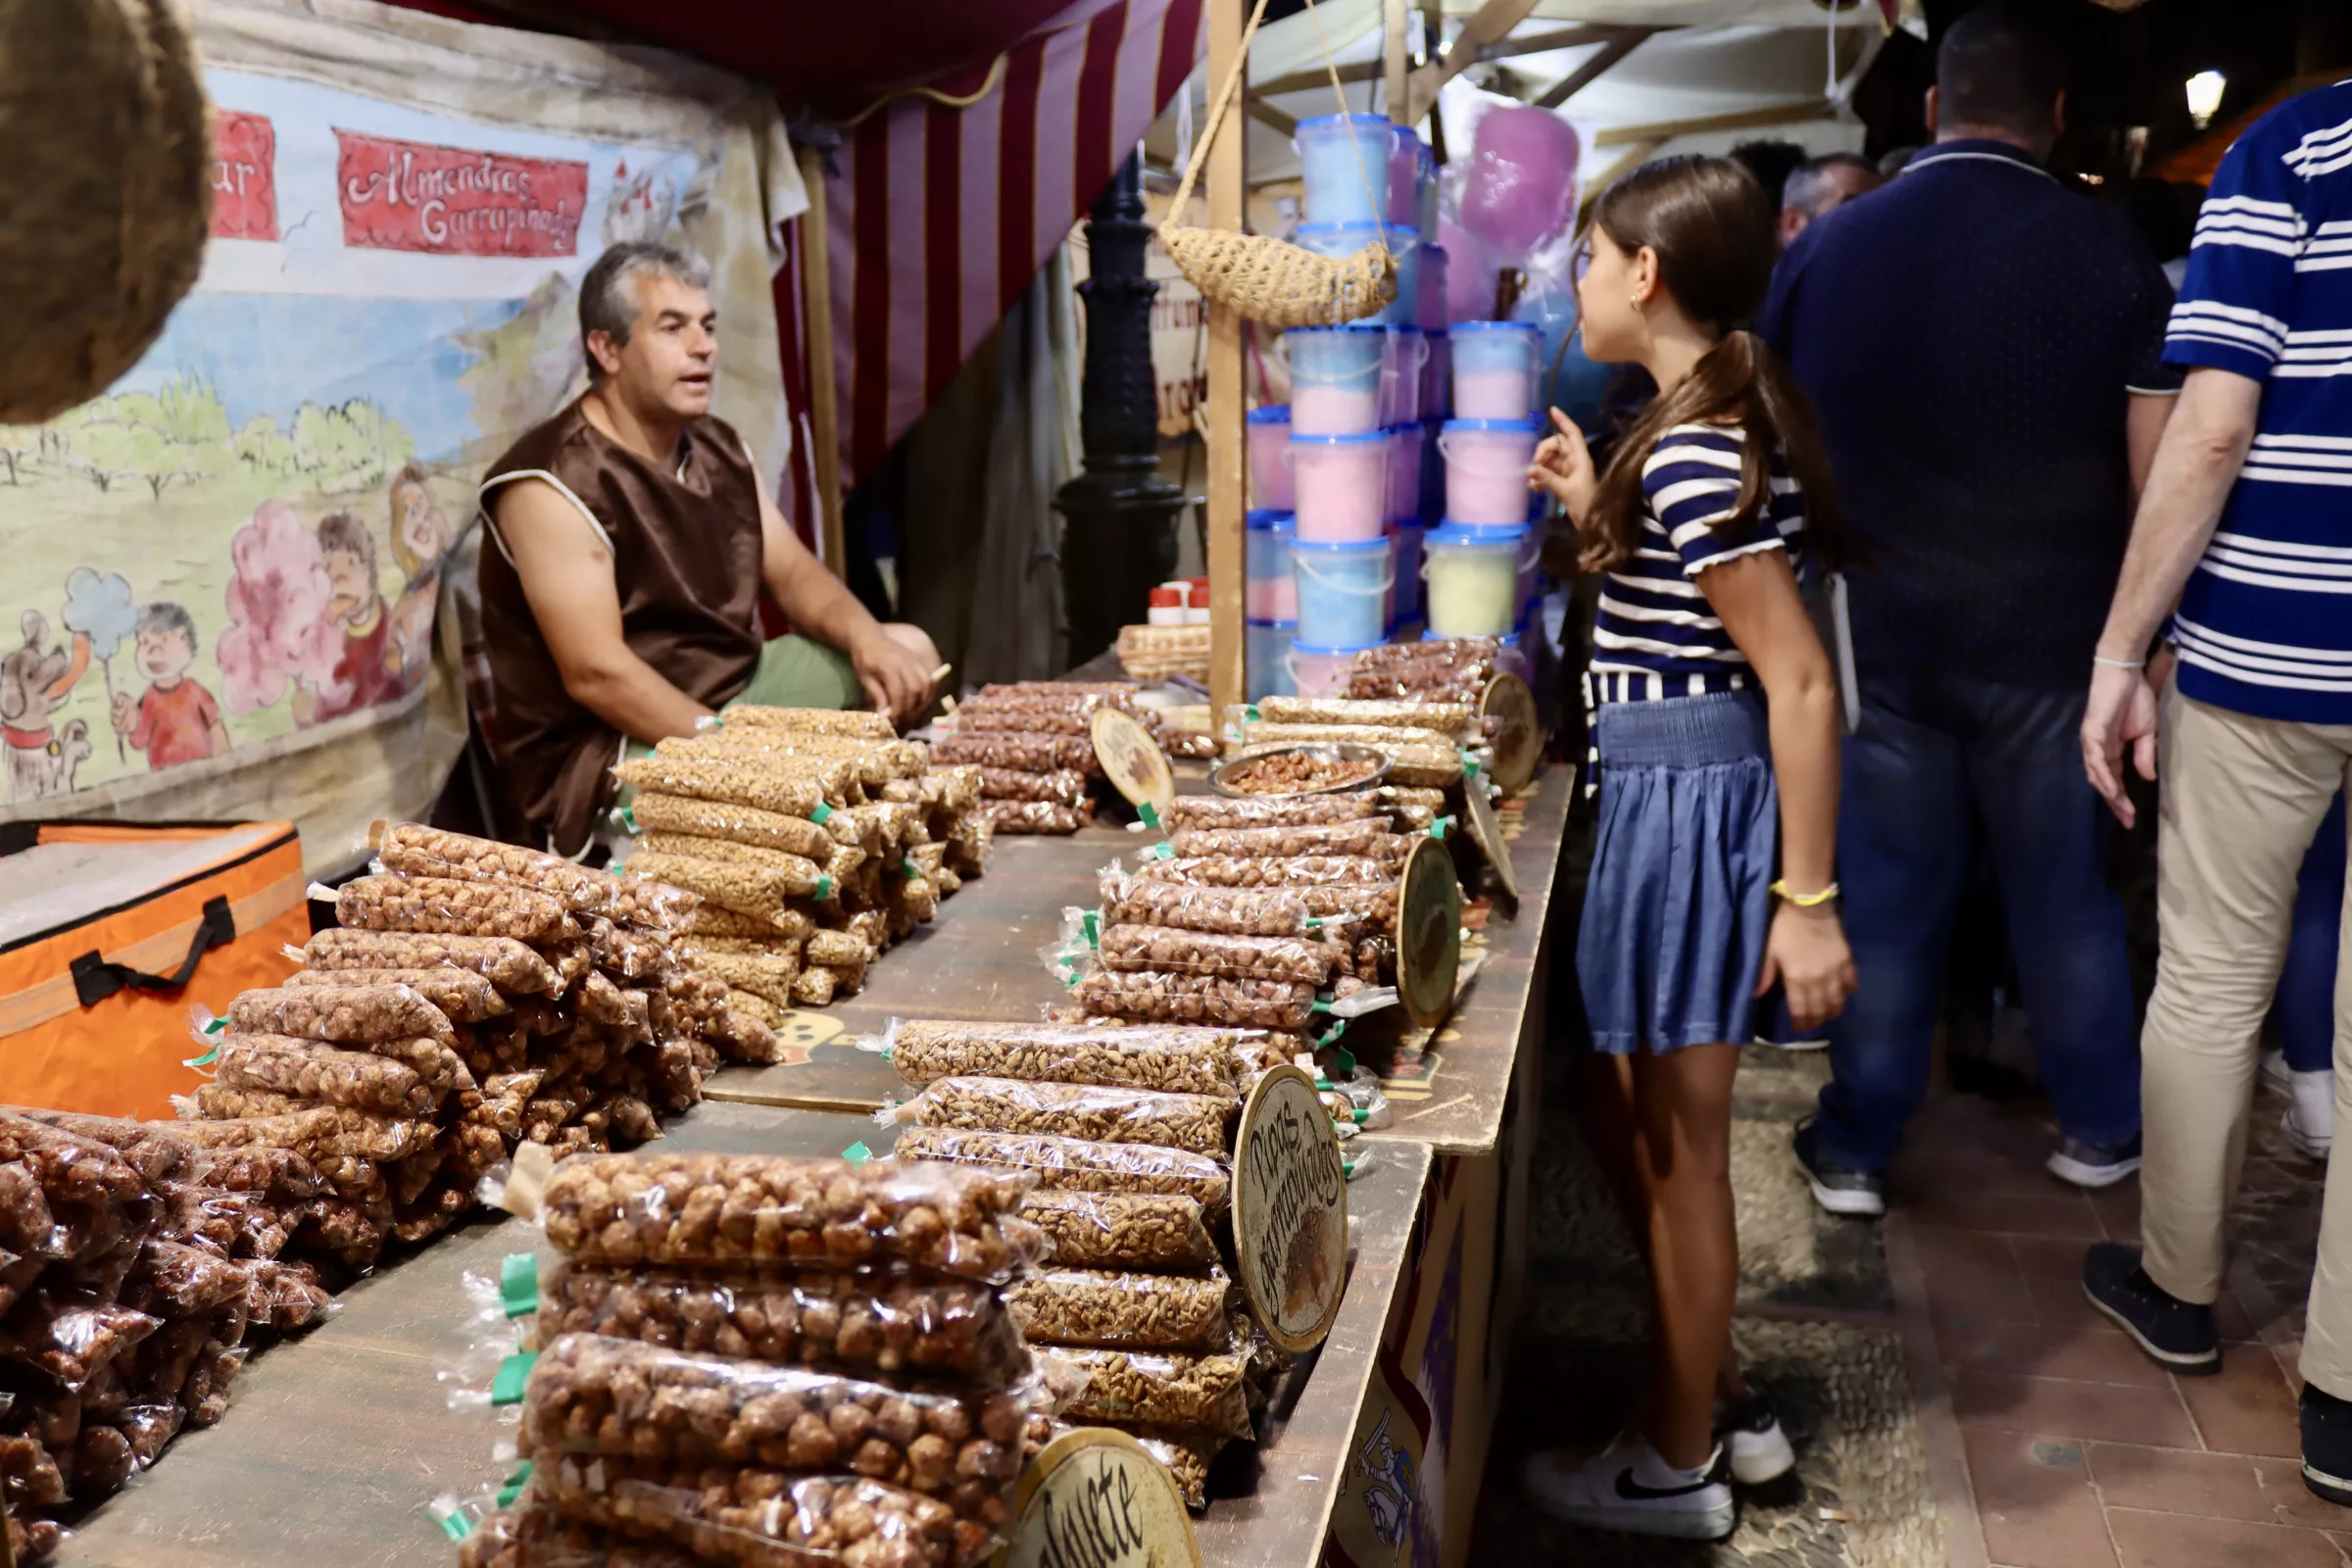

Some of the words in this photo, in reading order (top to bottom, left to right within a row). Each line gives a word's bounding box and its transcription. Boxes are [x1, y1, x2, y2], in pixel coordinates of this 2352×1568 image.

[348, 149, 530, 206] Almendras
[1250, 1102, 1299, 1202] Pipas
[1041, 1451, 1143, 1568] huete
